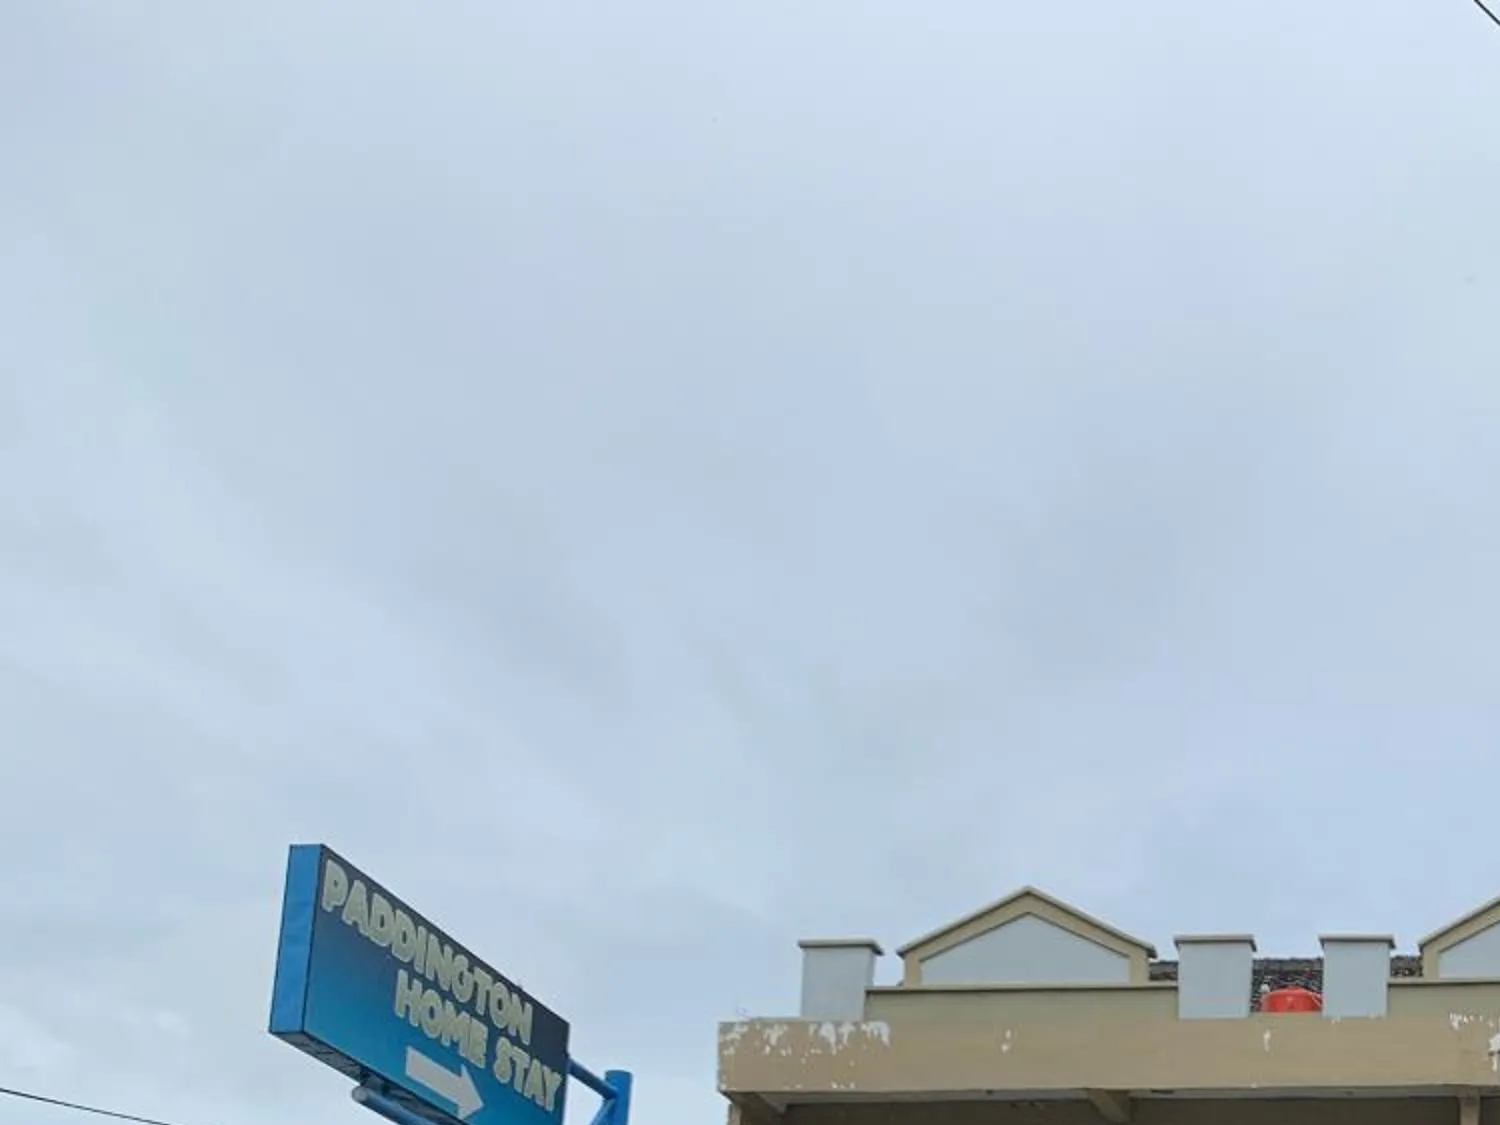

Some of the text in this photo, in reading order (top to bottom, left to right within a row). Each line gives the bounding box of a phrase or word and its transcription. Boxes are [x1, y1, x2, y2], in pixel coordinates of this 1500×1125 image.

[320, 858, 534, 1047] PADDINGTON
[394, 968, 563, 1112] HOME STAY
